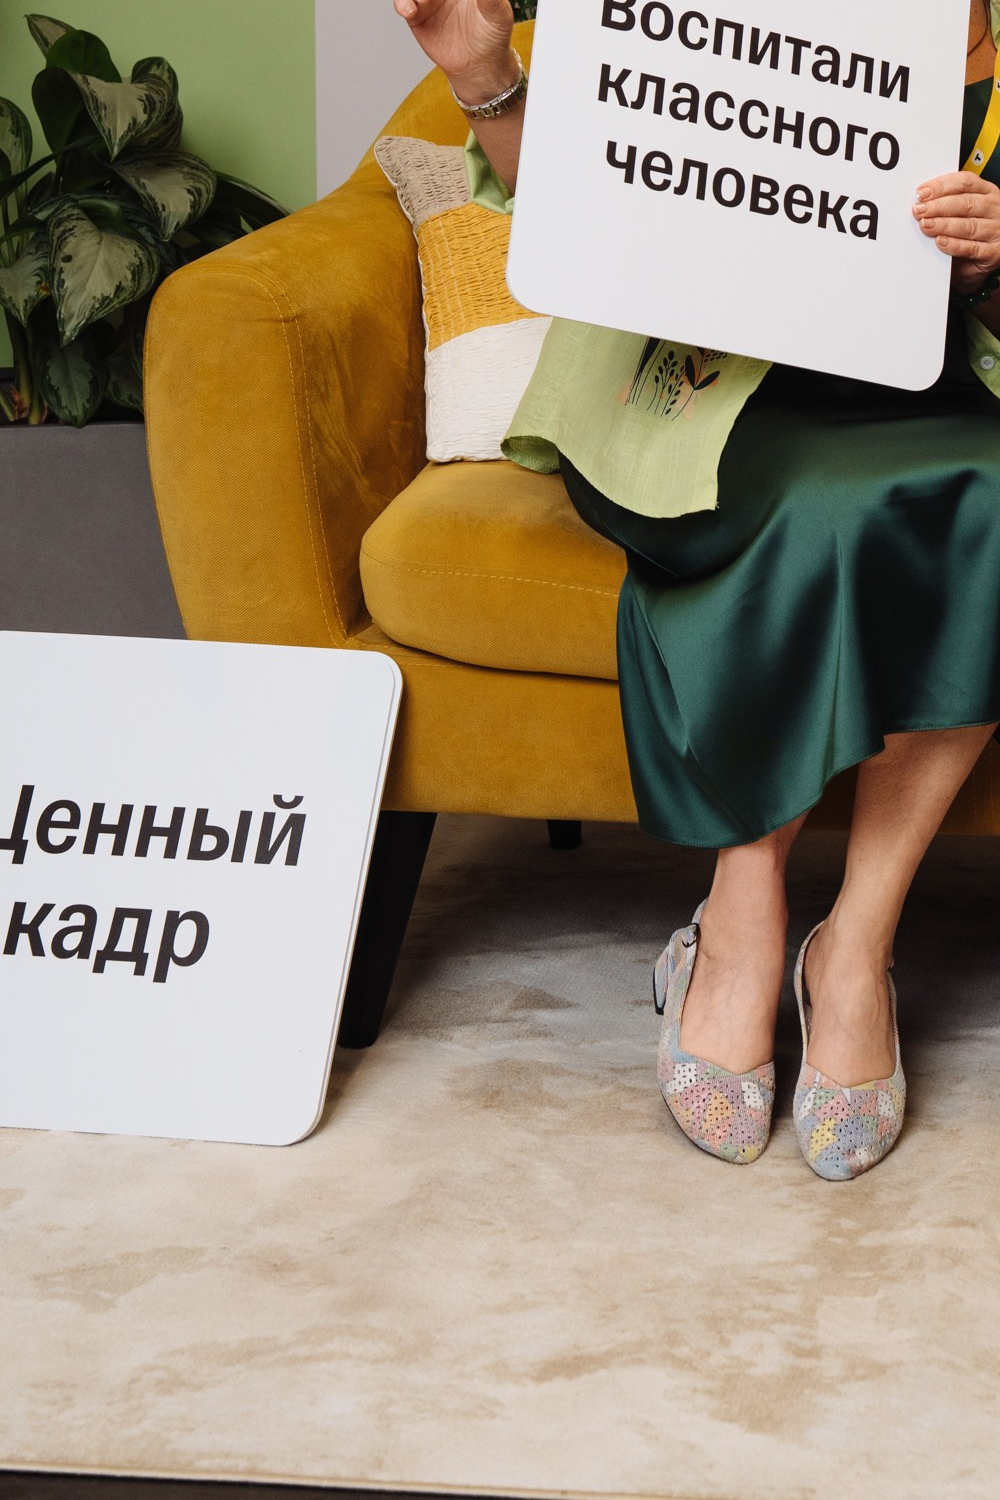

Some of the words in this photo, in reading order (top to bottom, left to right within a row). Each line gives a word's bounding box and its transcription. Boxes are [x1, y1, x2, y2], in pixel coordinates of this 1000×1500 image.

[597, 63, 900, 171] классного
[606, 140, 879, 241] человека
[2, 901, 210, 984] кадр
